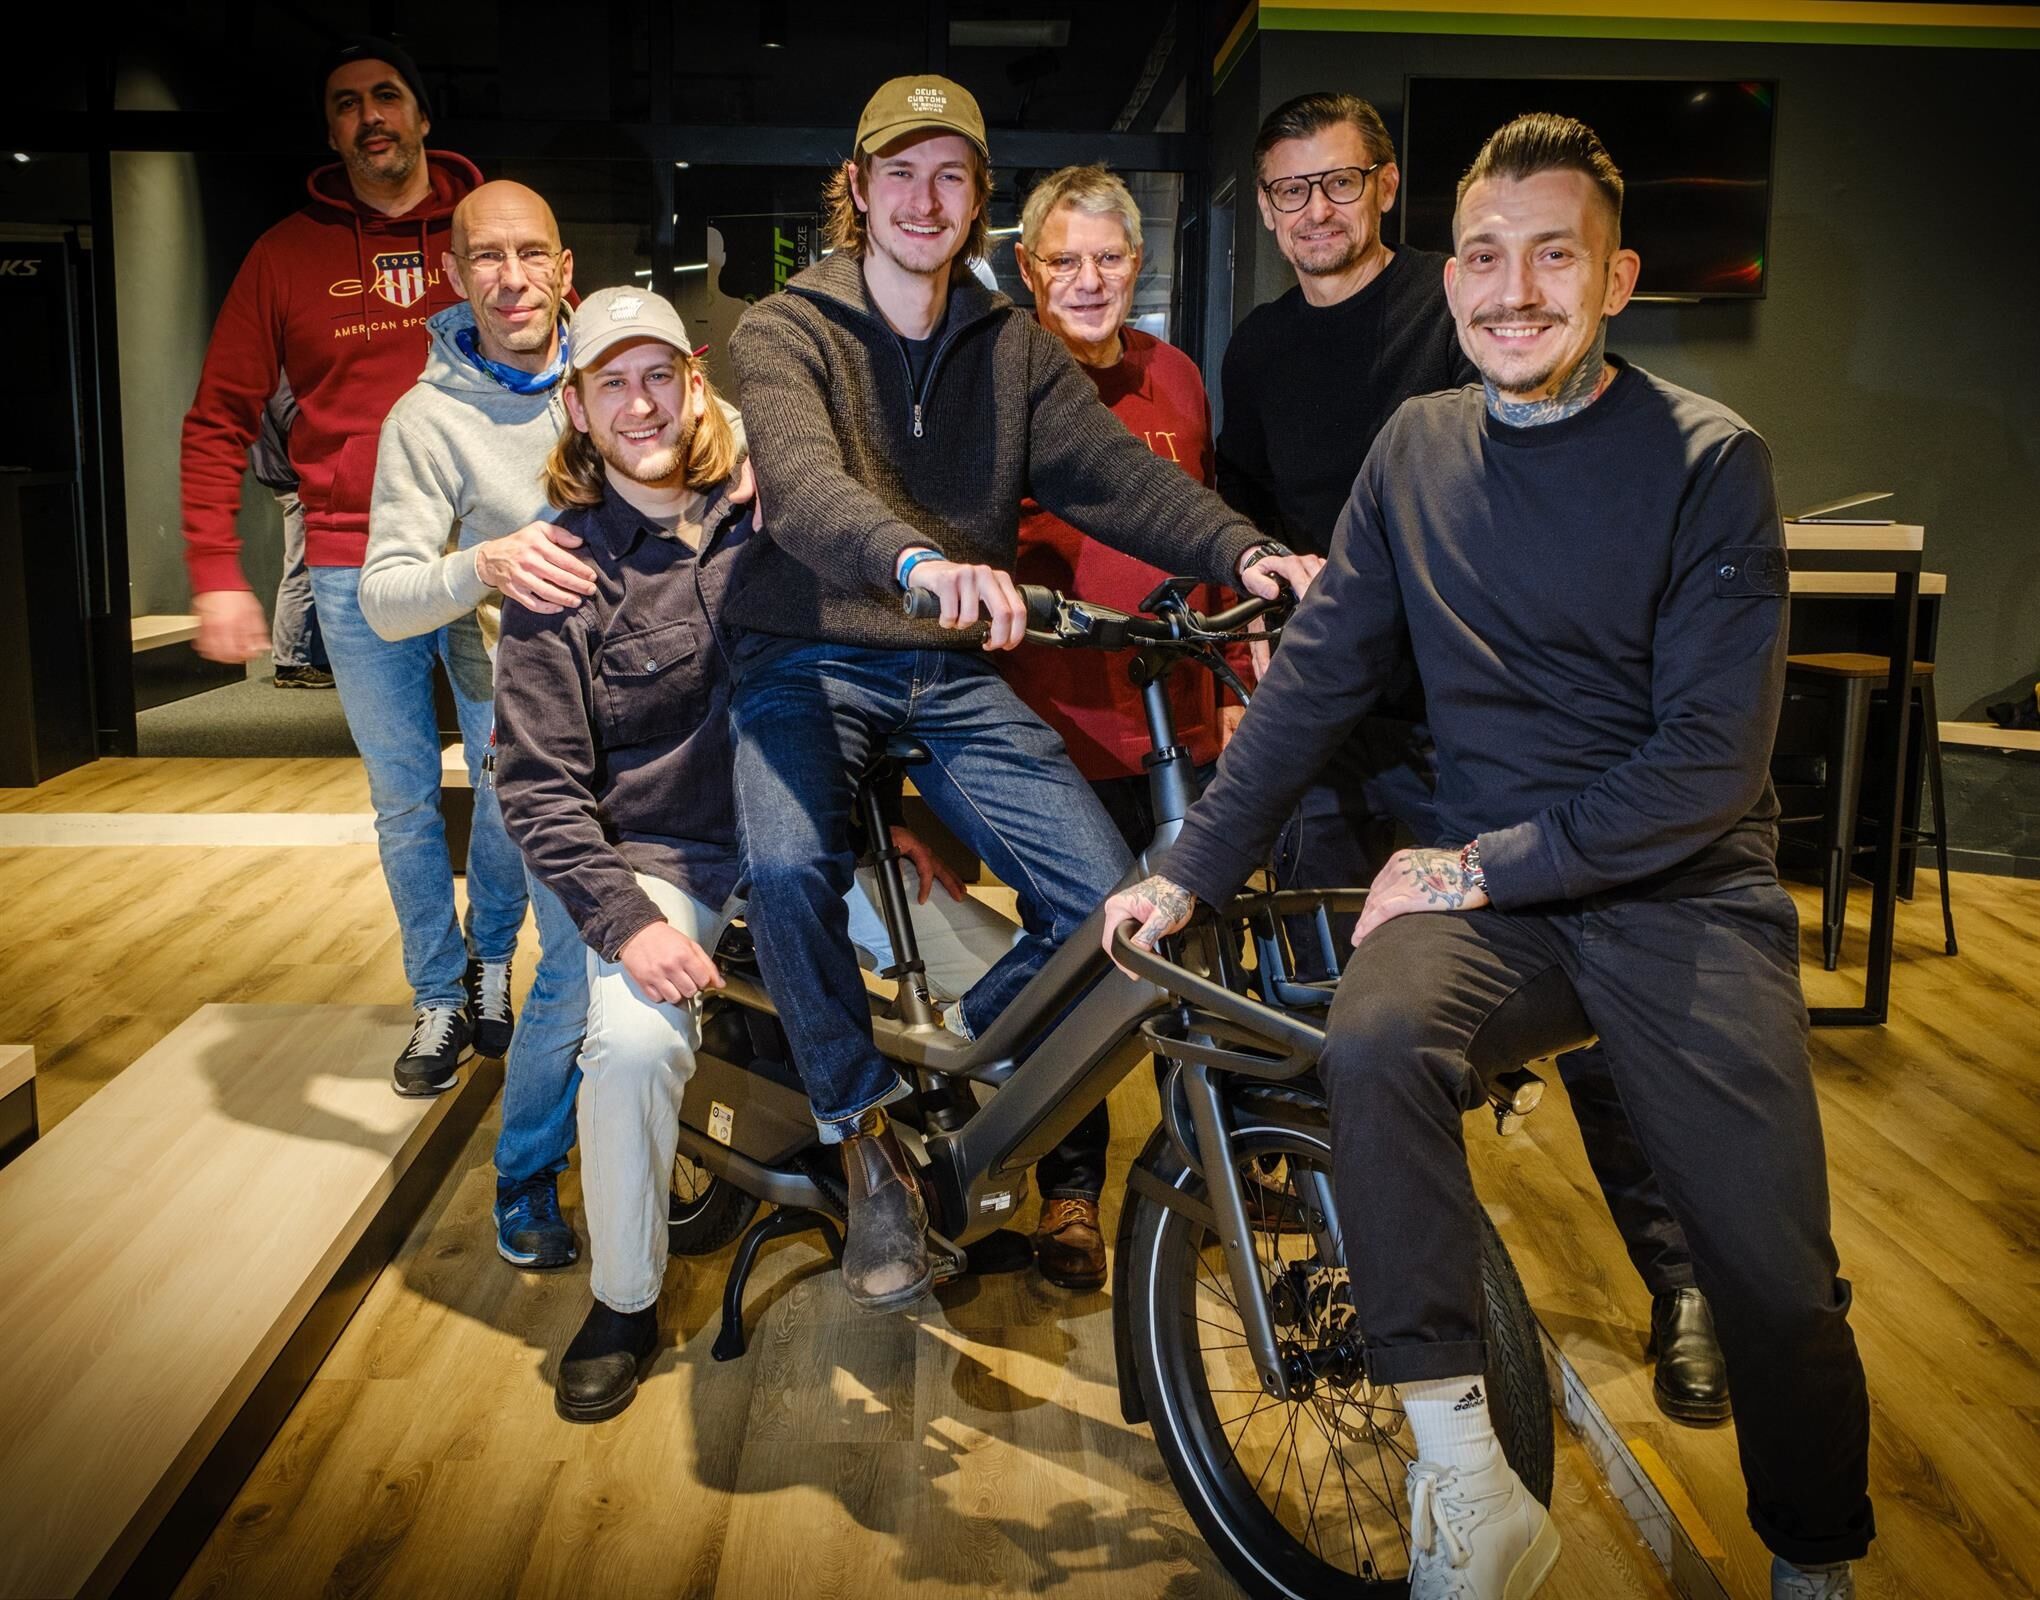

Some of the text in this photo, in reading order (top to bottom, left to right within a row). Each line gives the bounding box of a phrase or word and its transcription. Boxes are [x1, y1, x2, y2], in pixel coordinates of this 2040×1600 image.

[798, 225, 808, 253] SIZE
[381, 256, 420, 268] 1949
[329, 268, 446, 296] GAN
[334, 320, 397, 338] AMERCAN
